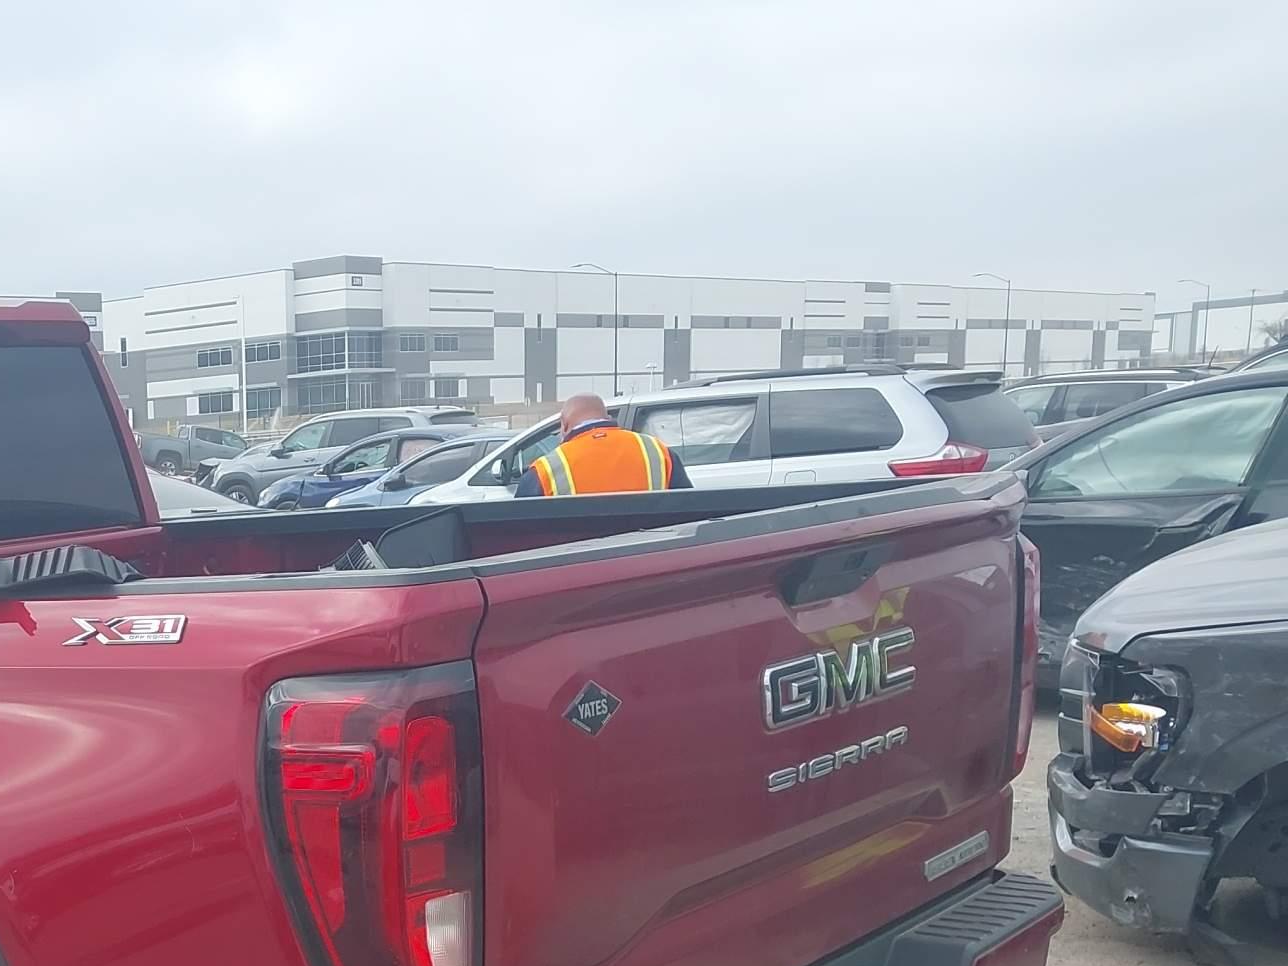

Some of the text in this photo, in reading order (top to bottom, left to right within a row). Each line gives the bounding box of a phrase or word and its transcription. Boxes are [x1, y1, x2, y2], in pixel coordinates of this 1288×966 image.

[61, 614, 186, 646] X31
[763, 626, 917, 730] GMC
[577, 698, 609, 720] YATES
[767, 725, 909, 793] SIERRA
